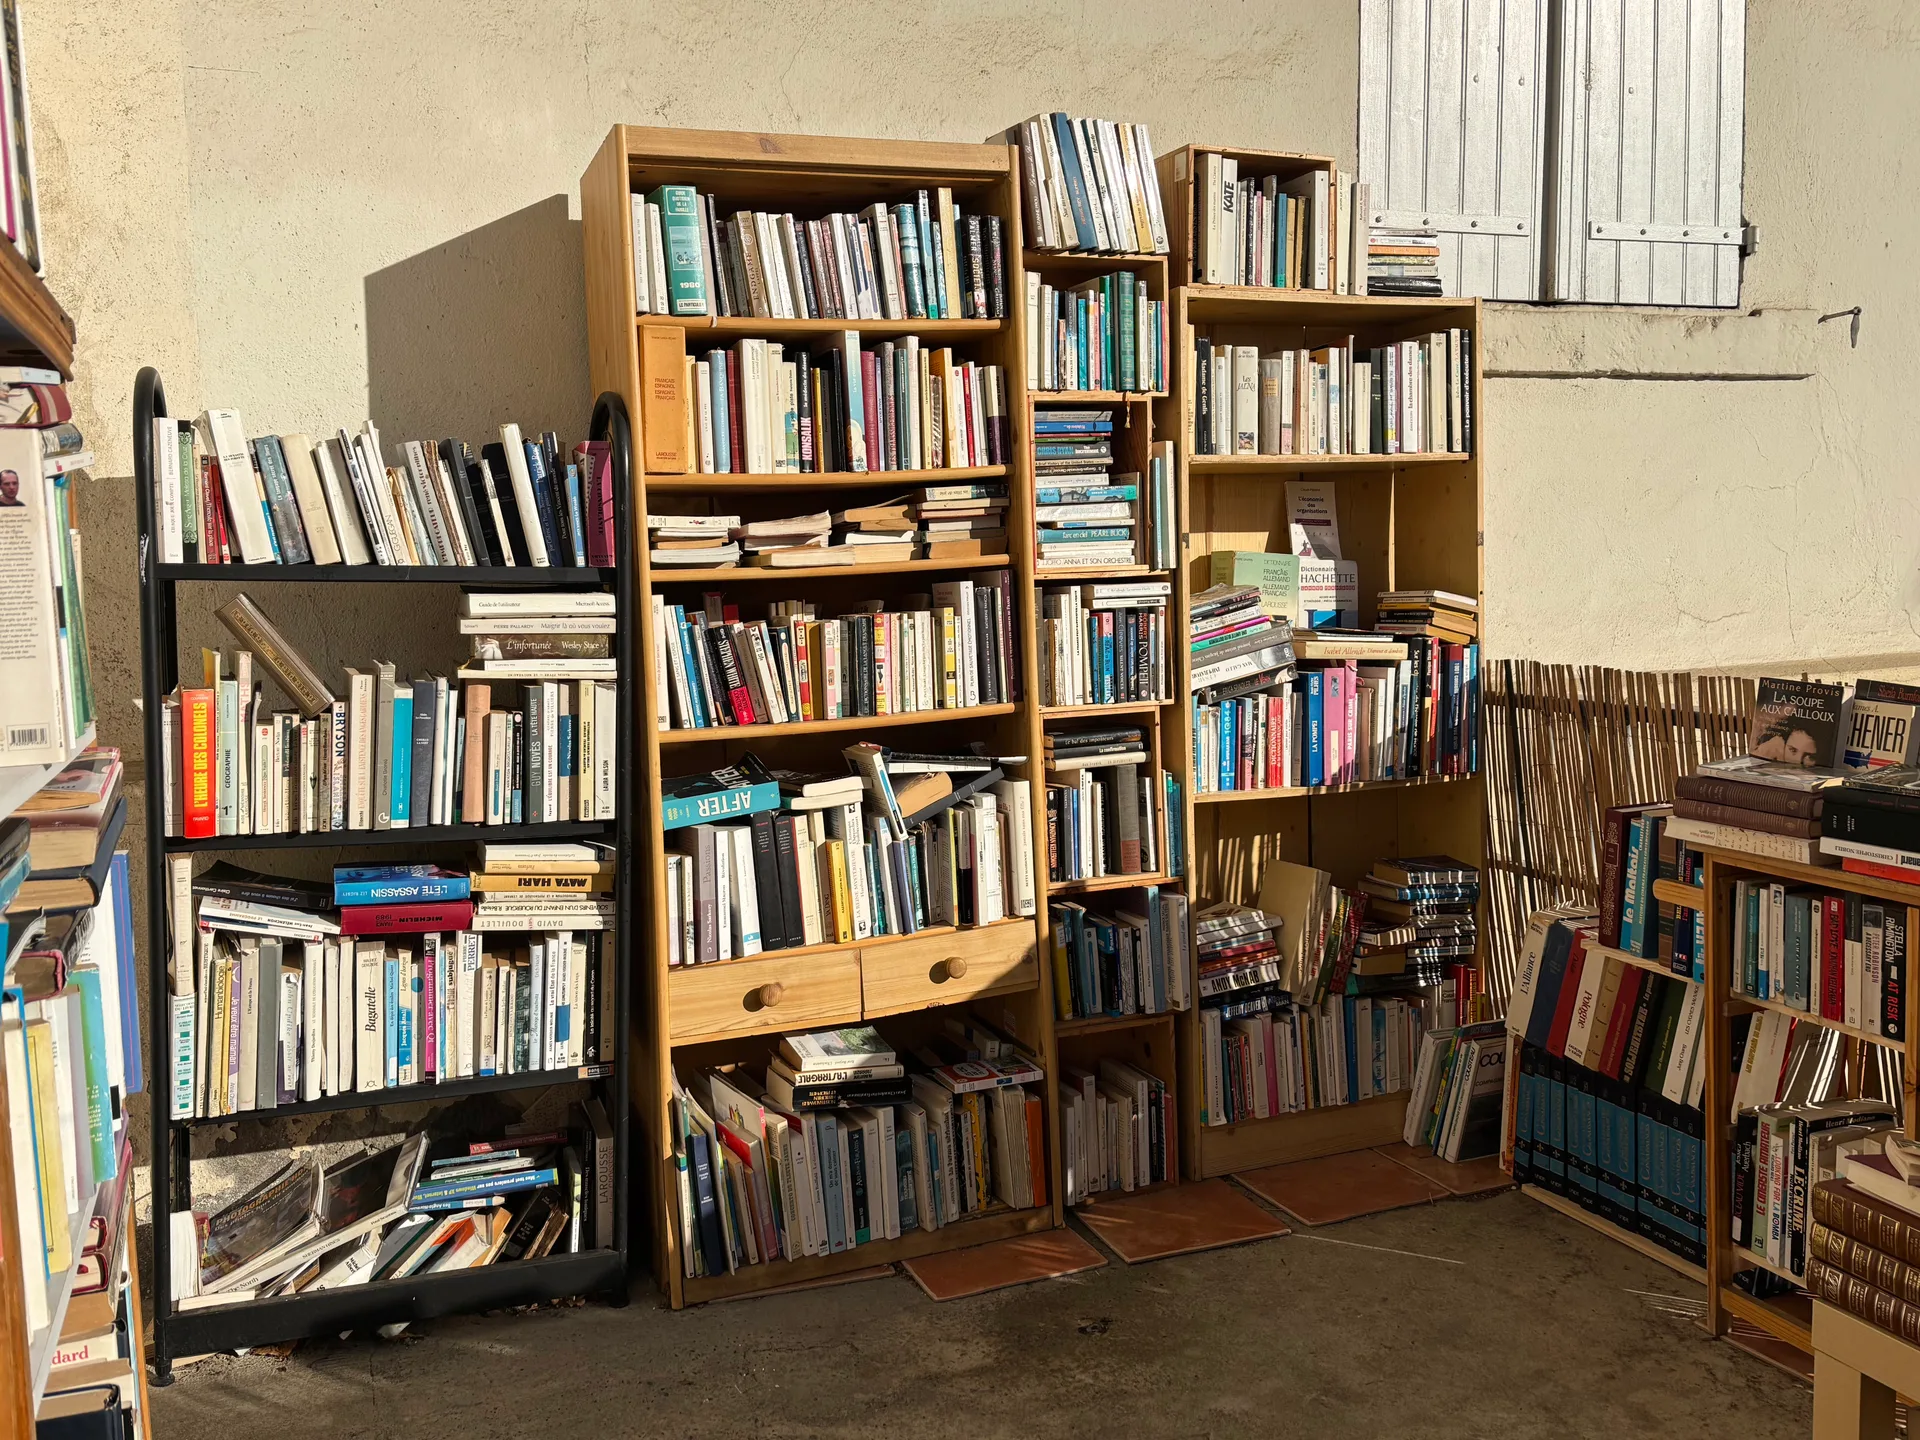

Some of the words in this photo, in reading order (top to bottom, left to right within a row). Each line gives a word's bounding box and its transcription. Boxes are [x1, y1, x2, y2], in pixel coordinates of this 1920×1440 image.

[1222, 181, 1234, 213] KATE
[969, 220, 977, 251] PALMER
[679, 281, 701, 289] 1980
[801, 417, 812, 461] KONSALIK
[1037, 447, 1057, 455] CHRIS
[1057, 446, 1074, 454] RYAN
[1111, 528, 1127, 537] BUCK
[1301, 574, 1356, 583] HACHETTE
[506, 640, 552, 654] L'infortunée
[561, 641, 582, 650] Wesley
[583, 641, 599, 649] Stace
[717, 639, 735, 667] STEPHEN
[1138, 641, 1149, 685] POMPEII
[725, 668, 741, 689] WHITE
[1762, 679, 1801, 692] Martine
[1806, 685, 1840, 697] Provis
[530, 698, 538, 716] HAUTE
[733, 690, 743, 712] CONTROL
[1773, 692, 1787, 704] LA
[1790, 695, 1824, 709] SOUPE
[529, 716, 538, 727] TÊTE
[1761, 705, 1781, 714] AUX
[1784, 708, 1834, 723] CAILLOUX
[193, 702, 207, 750] COLONELS
[334, 712, 346, 757] BRYSON
[532, 728, 538, 736] LA
[528, 741, 541, 768] NOVÈS
[1312, 744, 1318, 752] LA
[194, 751, 207, 770] DES
[532, 771, 542, 786] GUY
[194, 771, 208, 808] L'HEURE
[697, 790, 751, 817] AFTER
[1835, 846, 1855, 854] NOBILI
[1856, 848, 1893, 860] CHRISTOPHE
[702, 844, 711, 883] Passions
[518, 877, 551, 887] HARI
[555, 878, 587, 888] MATA
[1625, 846, 1639, 904] Maltais
[371, 886, 419, 897] ASSASSIN
[1623, 908, 1634, 923] le
[1829, 913, 1838, 929] BAD
[1830, 930, 1839, 948] LOVE
[1872, 932, 1880, 949] PETER
[1885, 917, 1895, 963] RIMINGTON
[1894, 925, 1903, 956] STELLA
[467, 934, 476, 971] PERRET
[447, 951, 455, 986] subjugué
[1519, 951, 1536, 995] L'Alliance
[427, 958, 435, 1007] Programmer
[1212, 976, 1232, 992] ANDY
[1233, 970, 1259, 987] McNAB
[1887, 981, 1898, 992] AT
[214, 965, 225, 1020] Humanbiologie
[231, 996, 239, 1005] Je
[230, 1007, 238, 1025] veux
[364, 986, 379, 1033] Bagatelle
[400, 1009, 408, 1025] Attali
[1578, 990, 1592, 1029] Pologne
[1686, 1007, 1695, 1025] CYGNES
[1887, 995, 1898, 1021] RISK
[230, 1026, 238, 1038] être
[1624, 1006, 1649, 1076] SOLJENITSYNE
[229, 1040, 237, 1064] maman
[798, 1071, 848, 1084] L'ASTRAGALE
[1825, 1119, 1847, 1128] Henri
[1847, 1114, 1876, 1125] Modiano
[1759, 1121, 1770, 1165] AMATEUR
[1742, 1142, 1751, 1172] Auerbach
[599, 1147, 608, 1204] LAROUSSE
[215, 1180, 289, 1226] PHOTOGRAPHIE
[1756, 1206, 1765, 1216] LE
[1773, 1202, 1780, 1211] LA
